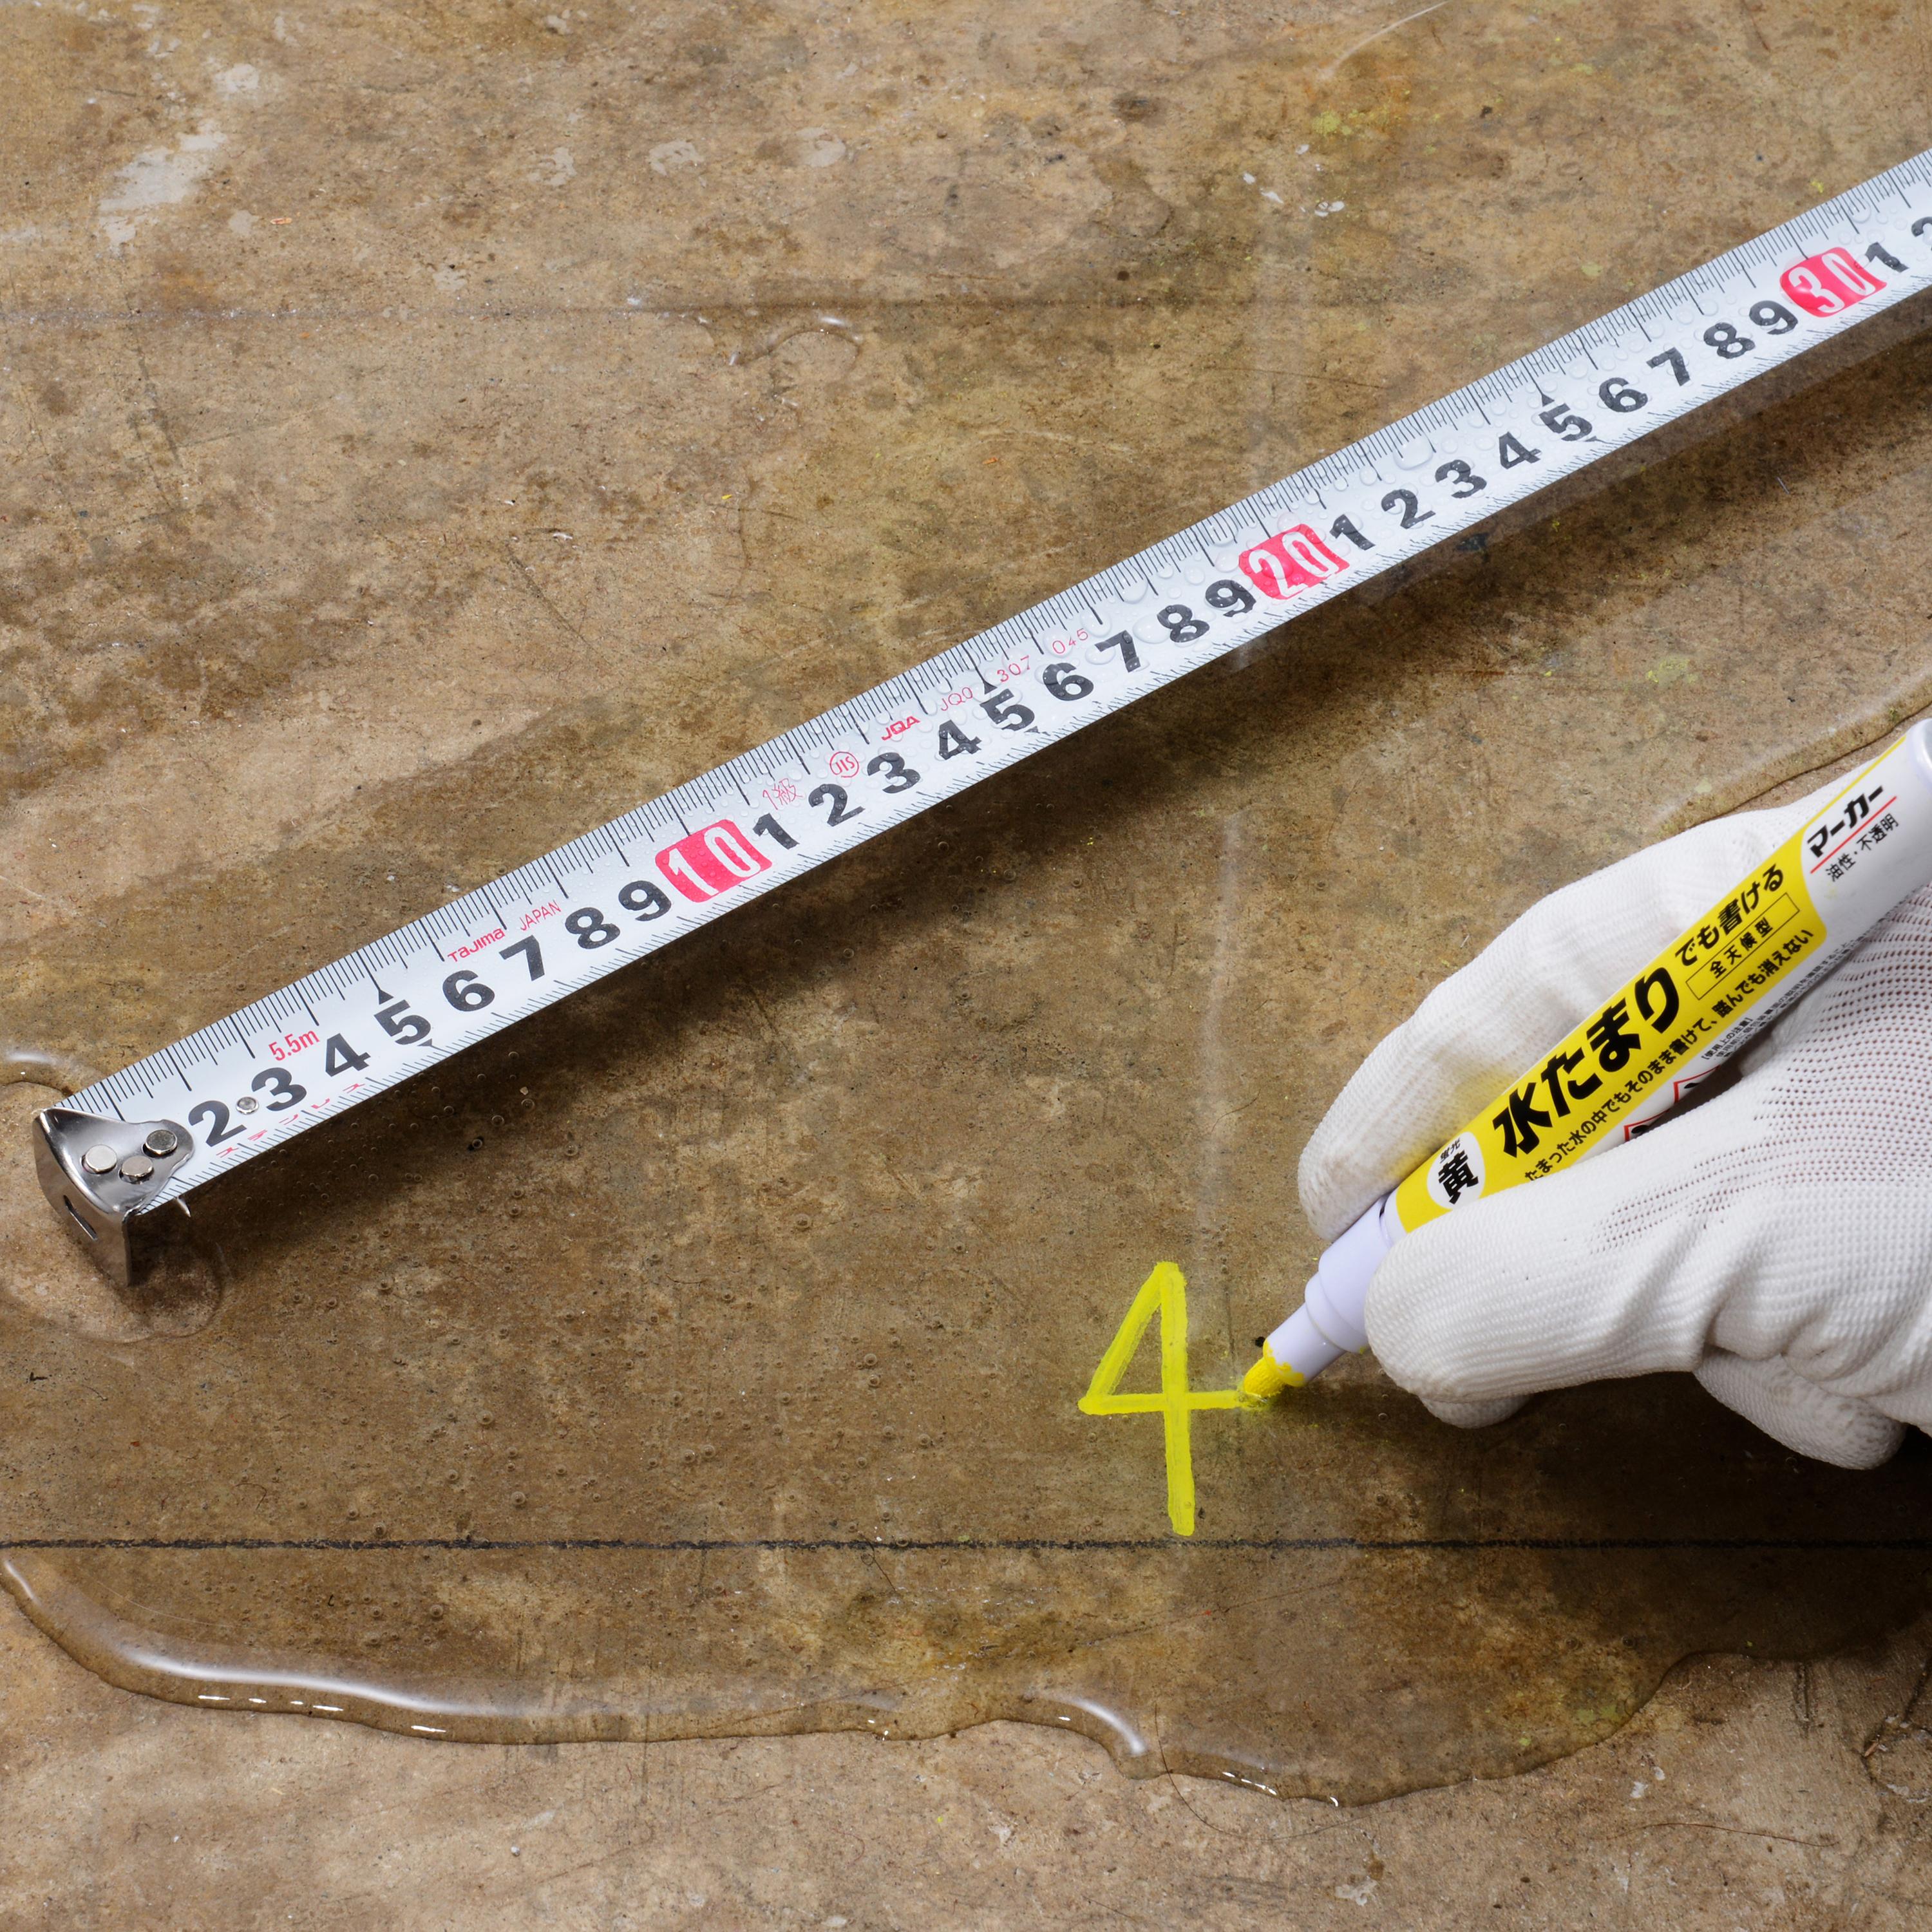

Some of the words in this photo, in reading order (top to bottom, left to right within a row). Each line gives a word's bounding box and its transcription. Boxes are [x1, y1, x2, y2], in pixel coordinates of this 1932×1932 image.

[189, 1101, 247, 1147] 2
[251, 1067, 307, 1112] 3
[325, 1033, 371, 1077] 4
[374, 999, 431, 1045] 5
[442, 970, 495, 1012] 6
[498, 934, 545, 981] 7
[565, 907, 621, 949] 8
[618, 880, 672, 922] 9
[668, 826, 761, 896] 10
[753, 813, 799, 849] 1
[808, 784, 865, 827] 2
[867, 752, 921, 793] 3
[938, 719, 981, 761] 4
[980, 688, 1035, 732] 5
[1043, 663, 1094, 701] 6
[1095, 630, 1141, 673] 7
[1157, 605, 1209, 643] 8
[1205, 580, 1256, 618] 9
[1249, 531, 1340, 597] 20
[1330, 514, 1375, 551] 1
[1381, 489, 1435, 529] 2
[1435, 460, 1487, 499] 3
[1499, 431, 1540, 469] 4
[1539, 403, 1593, 442] 5
[1598, 377, 1648, 413] 6
[1647, 348, 1690, 386] 7
[1703, 323, 1755, 359] 8
[1748, 301, 1798, 335] 9
[1788, 252, 1875, 313] 30
[1865, 242, 1908, 272] 1
[762, 778, 802, 810] 1級
[882, 715, 920, 741] JQA
[1807, 785, 1884, 858] マーカー
[1825, 813, 1899, 882] 油性・不透明
[519, 900, 562, 931] JAPAN
[1676, 864, 1784, 966] でも書ける
[1710, 917, 1774, 979] 全天候型
[269, 1030, 320, 1061] 5.5m
[1492, 967, 1680, 1158] 水たまり
[1438, 1150, 1479, 1205] 黄
[1078, 1261, 1264, 1536] 4
